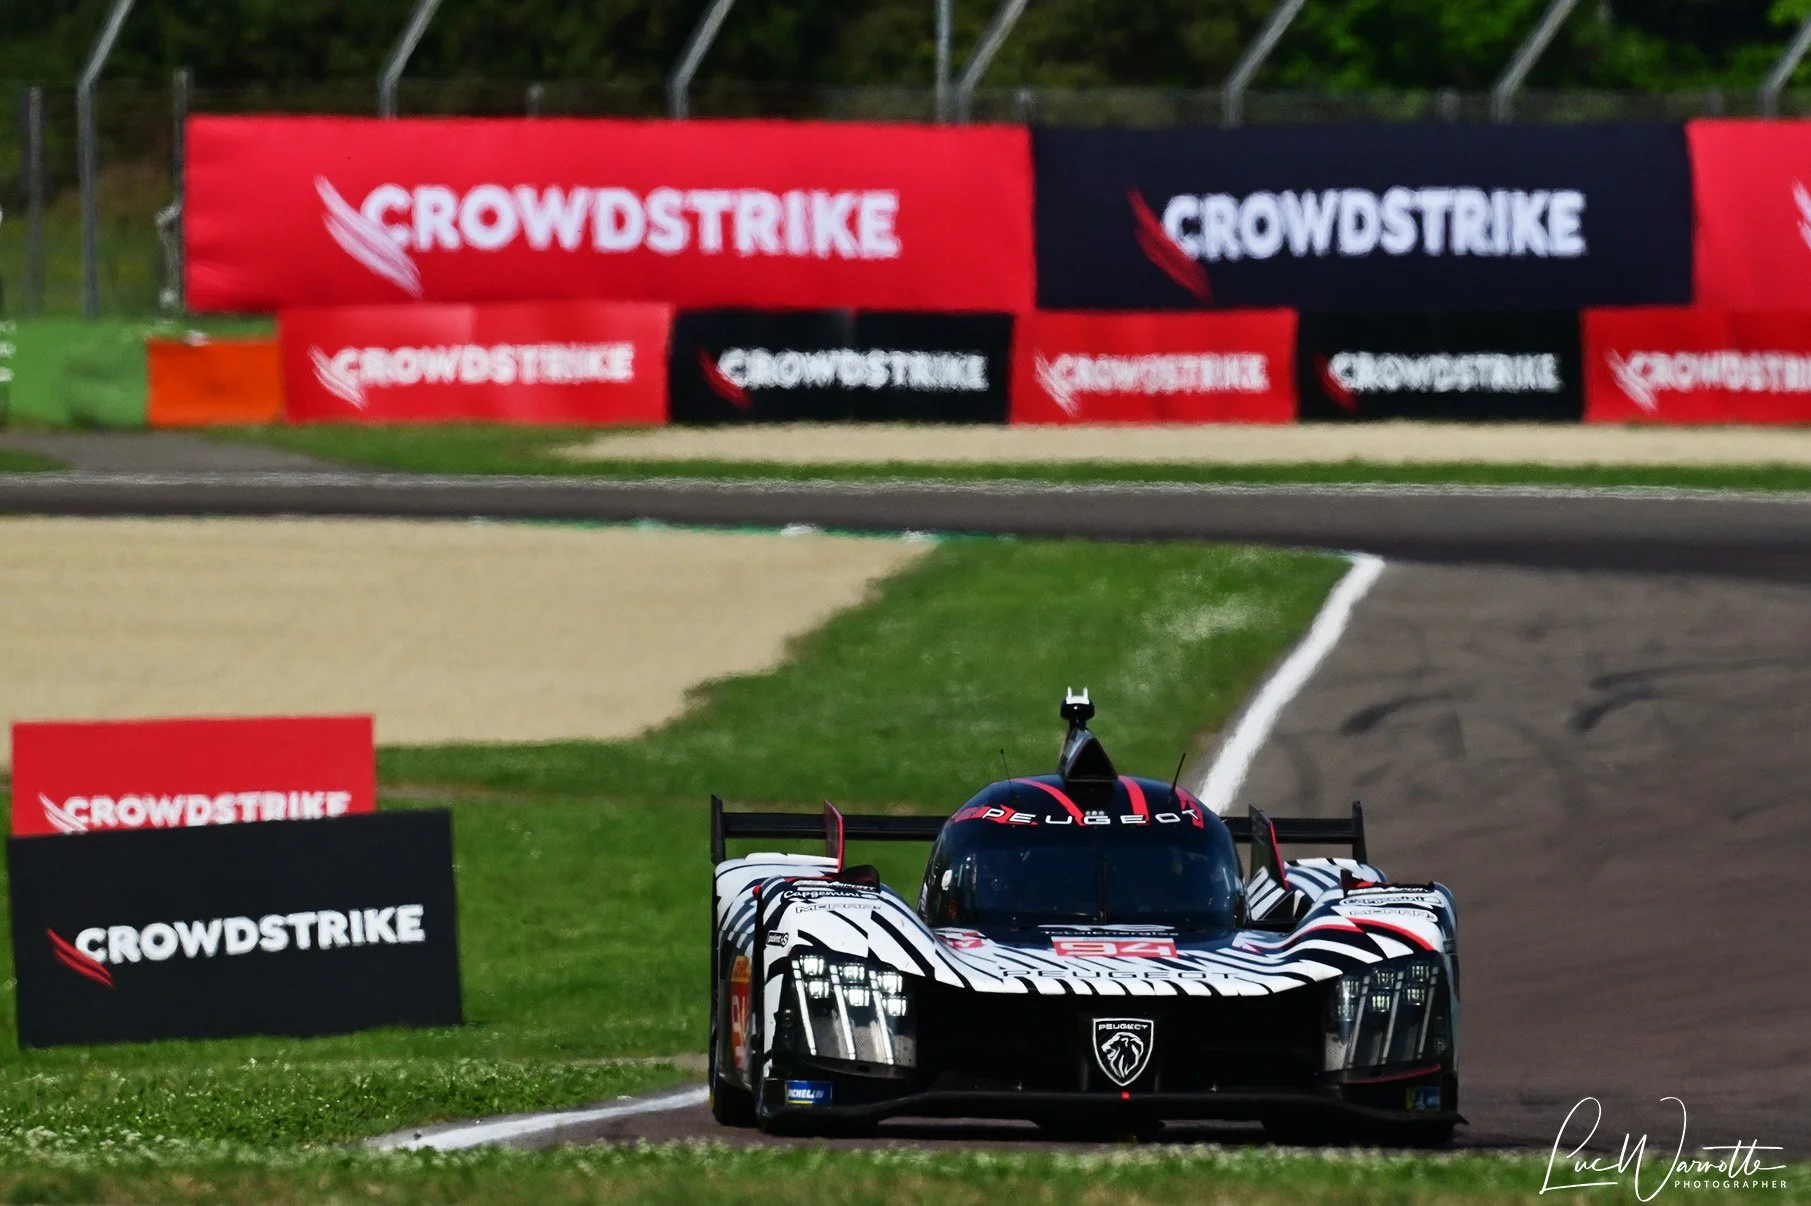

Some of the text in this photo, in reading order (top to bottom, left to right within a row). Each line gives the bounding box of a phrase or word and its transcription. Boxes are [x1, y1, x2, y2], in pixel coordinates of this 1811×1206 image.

[363, 184, 900, 259] CROWDSTRIKE
[1163, 187, 1586, 260] CROWDSTRIKE
[332, 342, 635, 386] CROWDSTRIKE
[717, 347, 988, 391] CROWDSTRIKE
[1056, 354, 1269, 393] CROWDSTRIKE
[1329, 352, 1560, 393] CROWDSTRIKE
[62, 790, 352, 828] CROWDSTRIKE
[982, 808, 1199, 825] PEUGEOT
[75, 903, 426, 964] CROWDSTRIKE
[1059, 942, 1173, 957] 94
[1002, 969, 1239, 979] PEUGEOT
[1098, 1023, 1149, 1031] PEUGEOT
